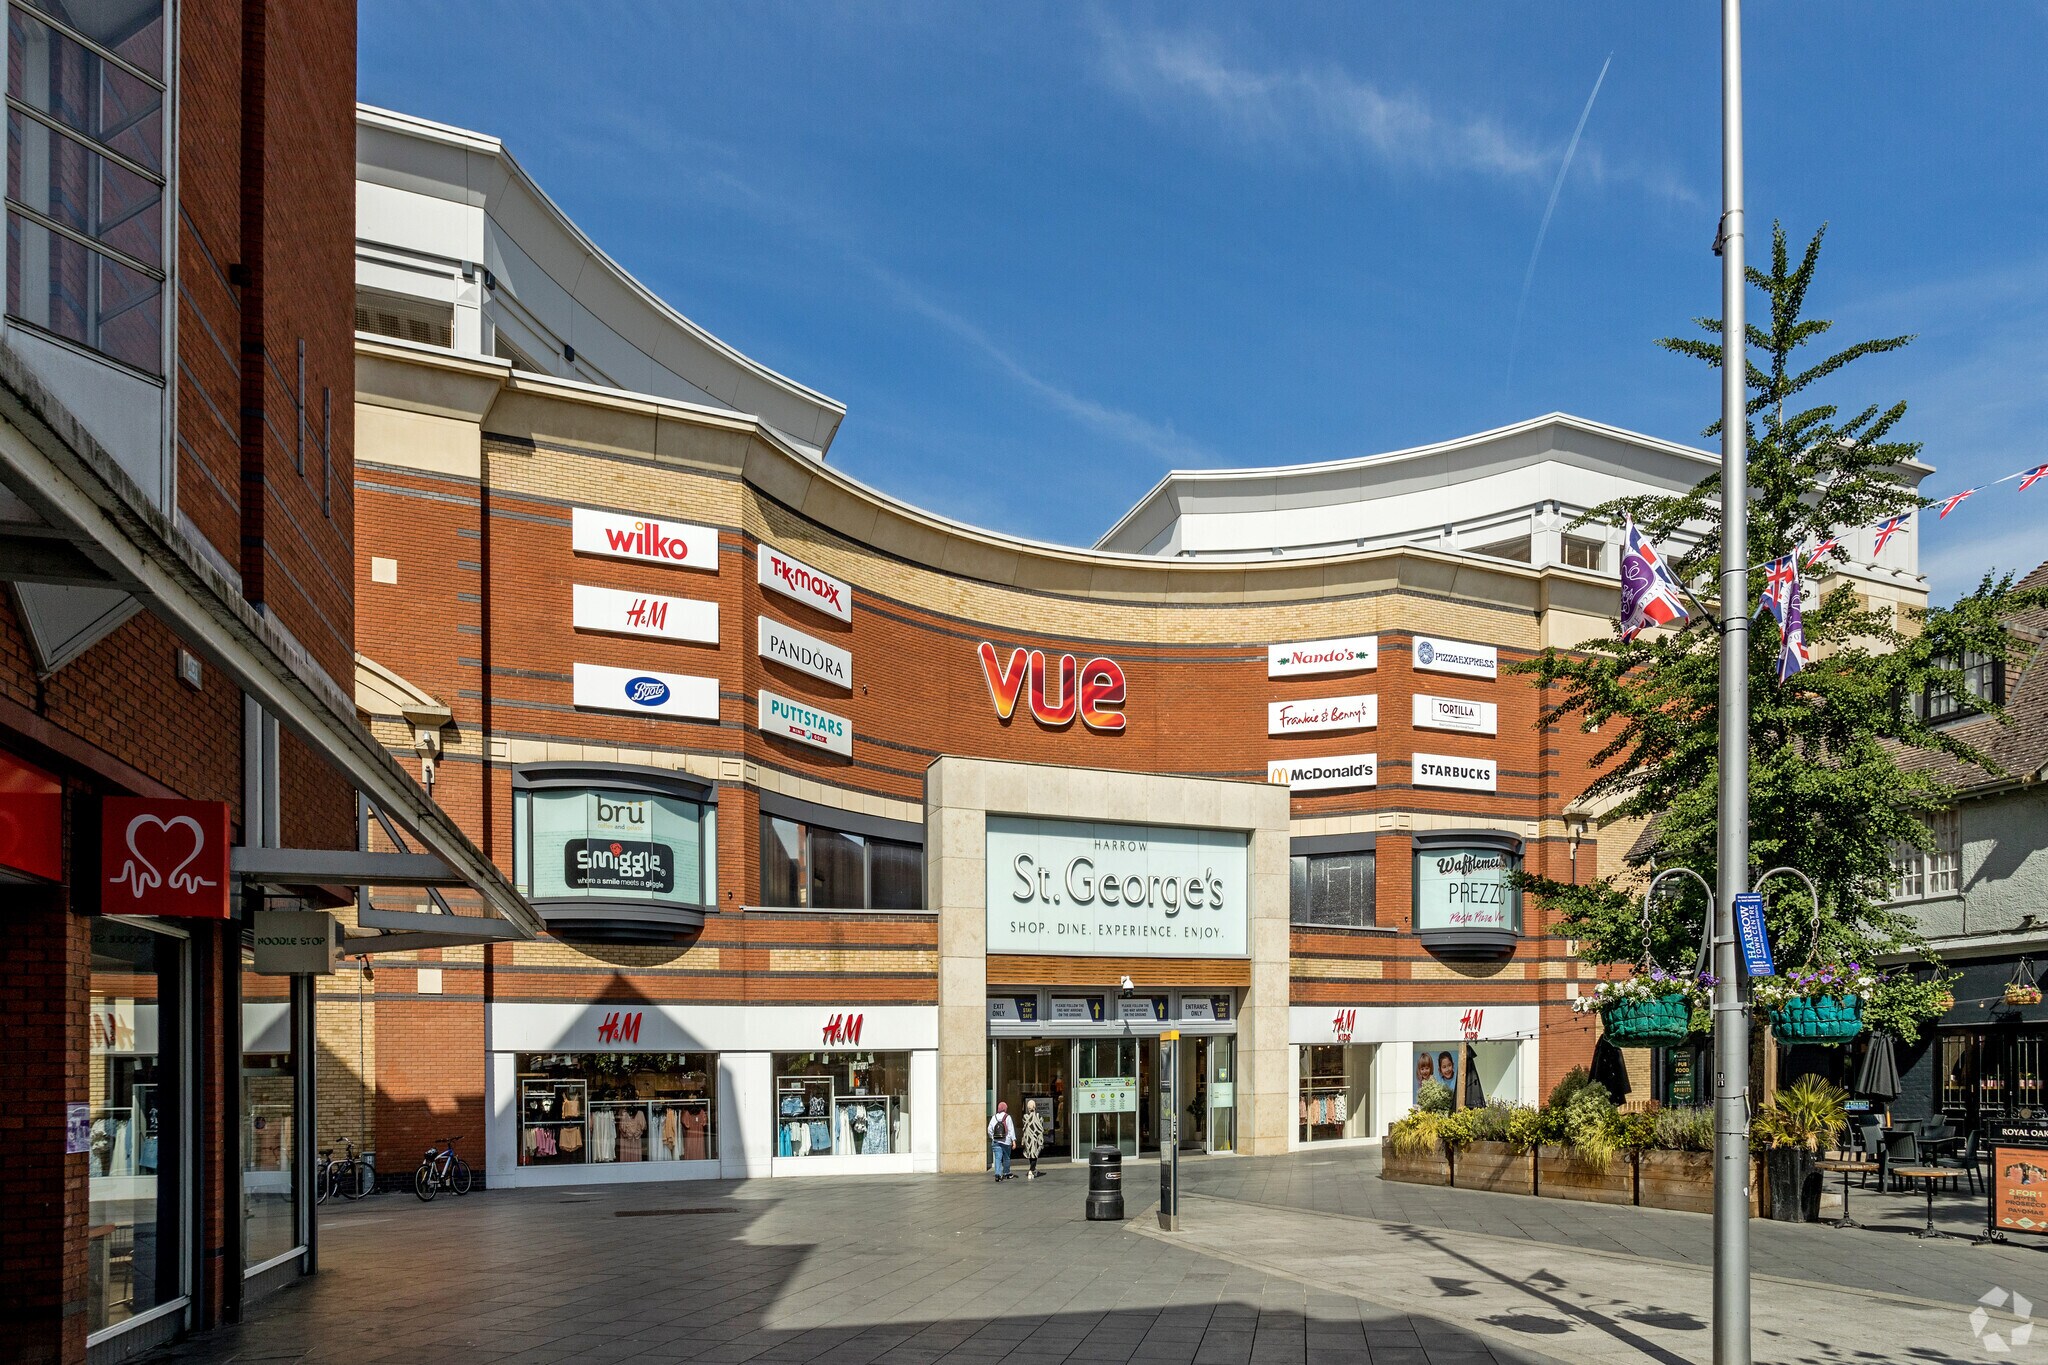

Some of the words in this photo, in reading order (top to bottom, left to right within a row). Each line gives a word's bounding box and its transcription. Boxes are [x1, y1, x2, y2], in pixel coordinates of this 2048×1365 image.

[605, 521, 688, 560] wilko
[627, 599, 668, 631] H&M
[770, 635, 844, 679] PANDORA
[1291, 649, 1355, 665] Nando's
[631, 681, 665, 702] Boots
[771, 700, 843, 737] PUTTSTARS
[1279, 705, 1319, 728] Frankie
[1330, 702, 1367, 728] Benny's
[1438, 703, 1475, 717] TORTILLA
[1290, 764, 1373, 781] McDonald's
[1421, 763, 1491, 780] STARBUCKS
[594, 793, 645, 824] brü
[1093, 839, 1149, 852] HARROW
[576, 843, 661, 878] smiggle
[602, 877, 620, 885] smile
[1449, 882, 1506, 905] PREZZO
[1010, 921, 1050, 934] SHOP.
[1057, 923, 1092, 936] DINE.
[1098, 924, 1177, 938] EXPERIENCE.
[1184, 927, 1225, 939] ENJOY.
[1748, 904, 1758, 935] CENTRE
[257, 937, 297, 946] NOODLE
[300, 936, 326, 946] STOP
[1740, 905, 1757, 959] HARROW
[1753, 936, 1763, 959] TOWN
[598, 1012, 643, 1044] H&M
[822, 1013, 864, 1046] H&M
[1332, 1009, 1356, 1033] H&M
[1460, 1009, 1484, 1031] H&M
[1337, 1033, 1351, 1041] KIDS
[2001, 1128, 2029, 1136] ROYAL
[2005, 1199, 2047, 1208] PROSECCO
[2008, 1188, 2015, 1196] 2
[2015, 1189, 2037, 1197] FOR
